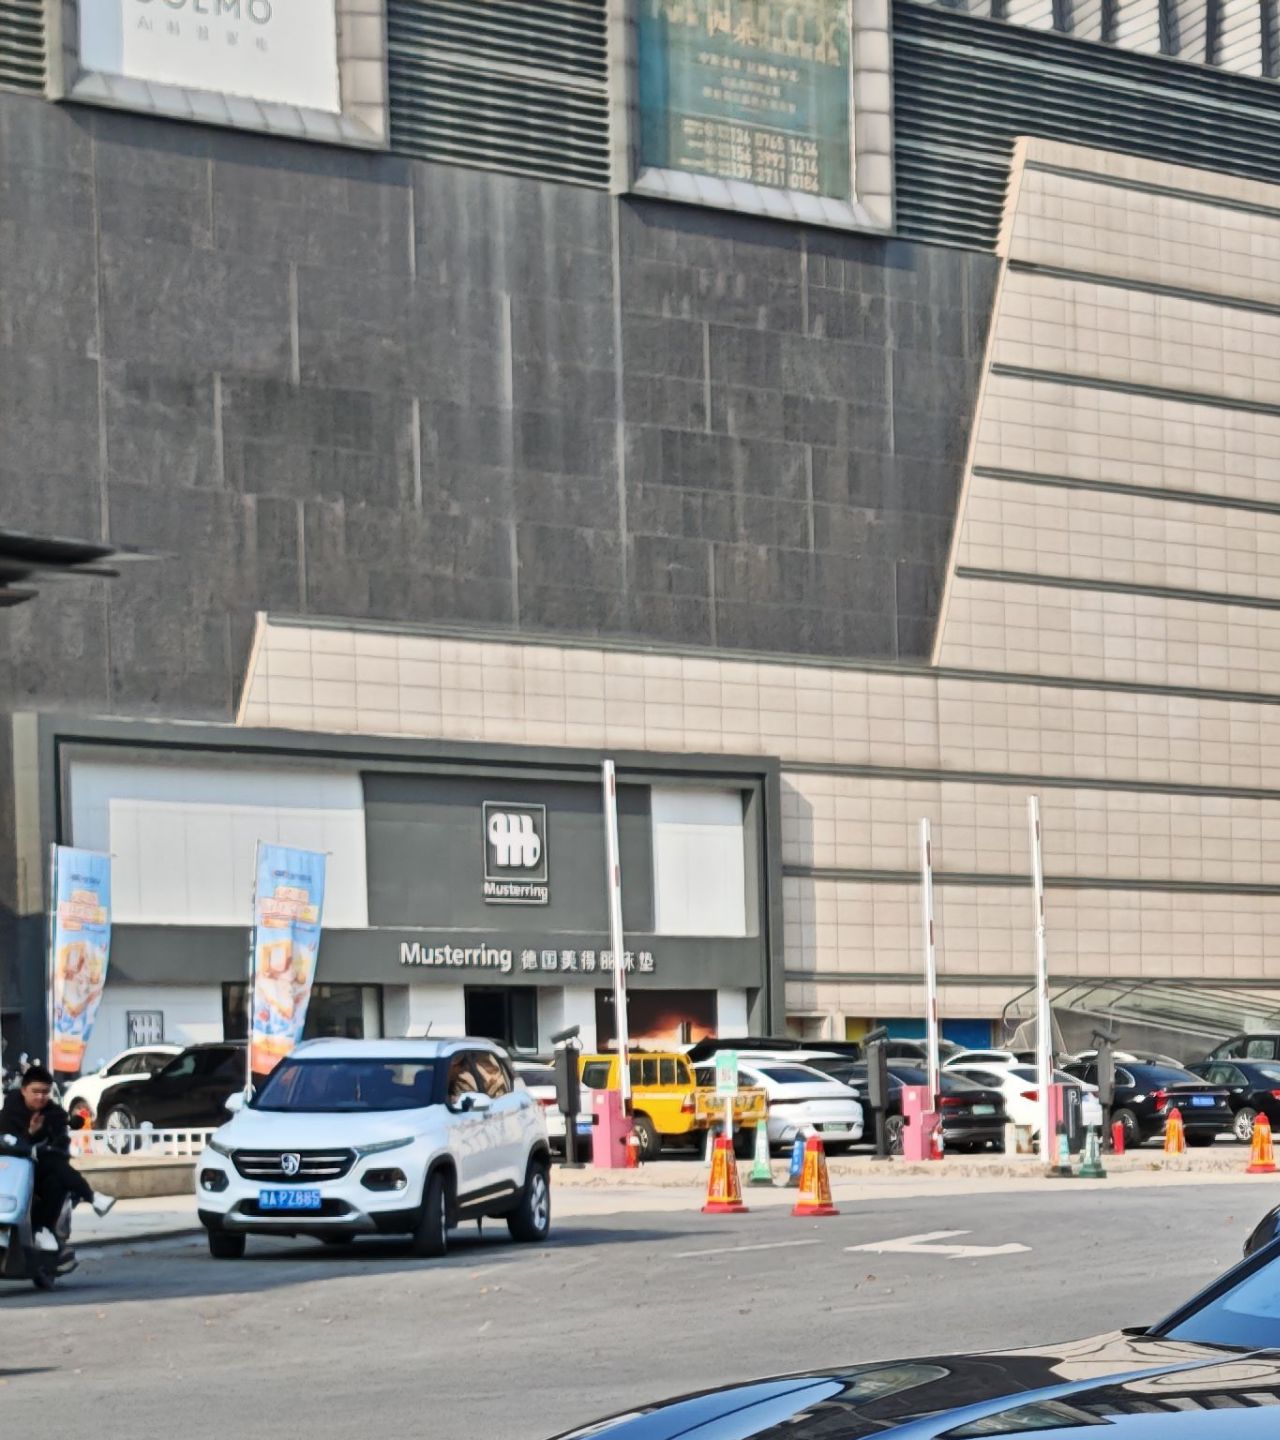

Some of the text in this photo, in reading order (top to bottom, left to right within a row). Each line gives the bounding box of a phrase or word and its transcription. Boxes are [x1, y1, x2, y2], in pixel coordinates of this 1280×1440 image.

[134, 0, 273, 24] LMO
[484, 881, 548, 903] Musterring
[400, 942, 512, 973] Musterring
